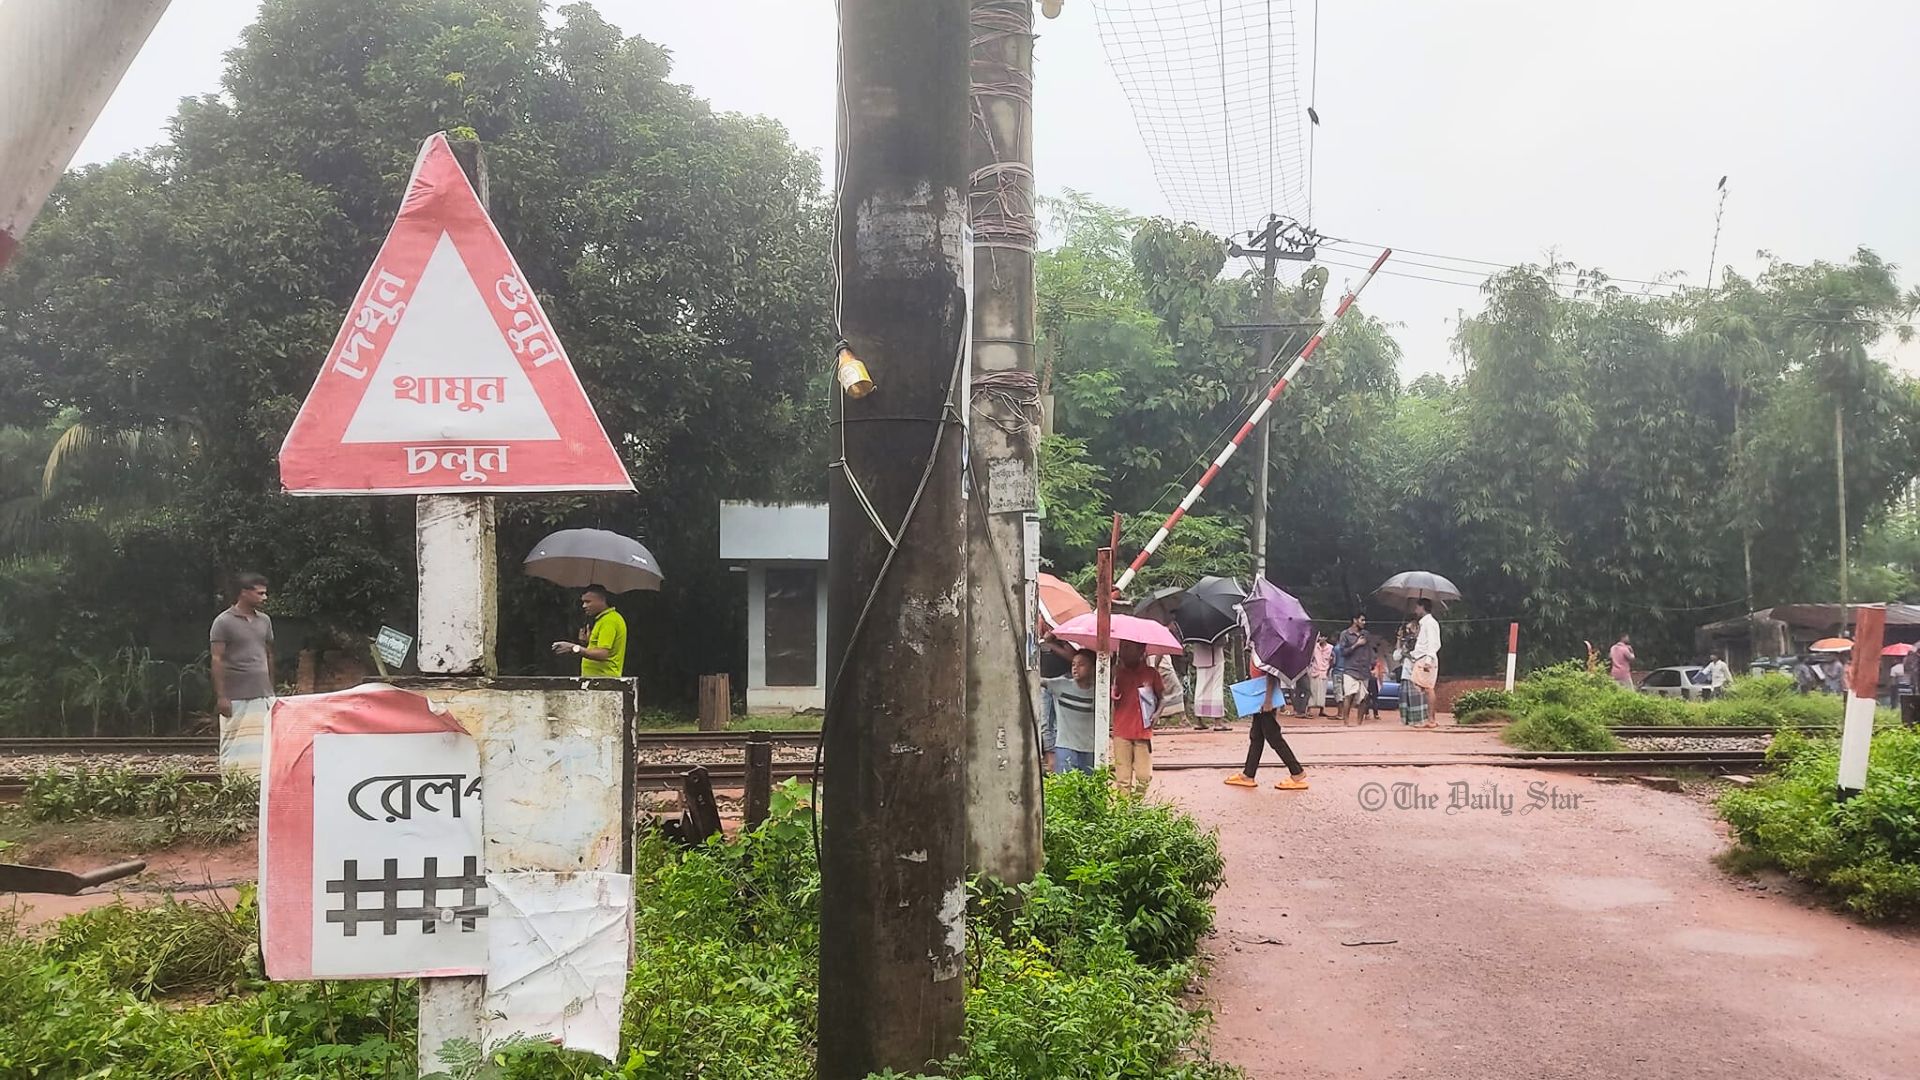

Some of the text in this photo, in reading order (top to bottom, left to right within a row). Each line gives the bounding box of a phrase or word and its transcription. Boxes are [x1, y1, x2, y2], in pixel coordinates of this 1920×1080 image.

[332, 266, 406, 379] দেখুন
[495, 267, 562, 368] শুনুন
[393, 375, 508, 413] থামুন
[403, 445, 510, 482] চলুন
